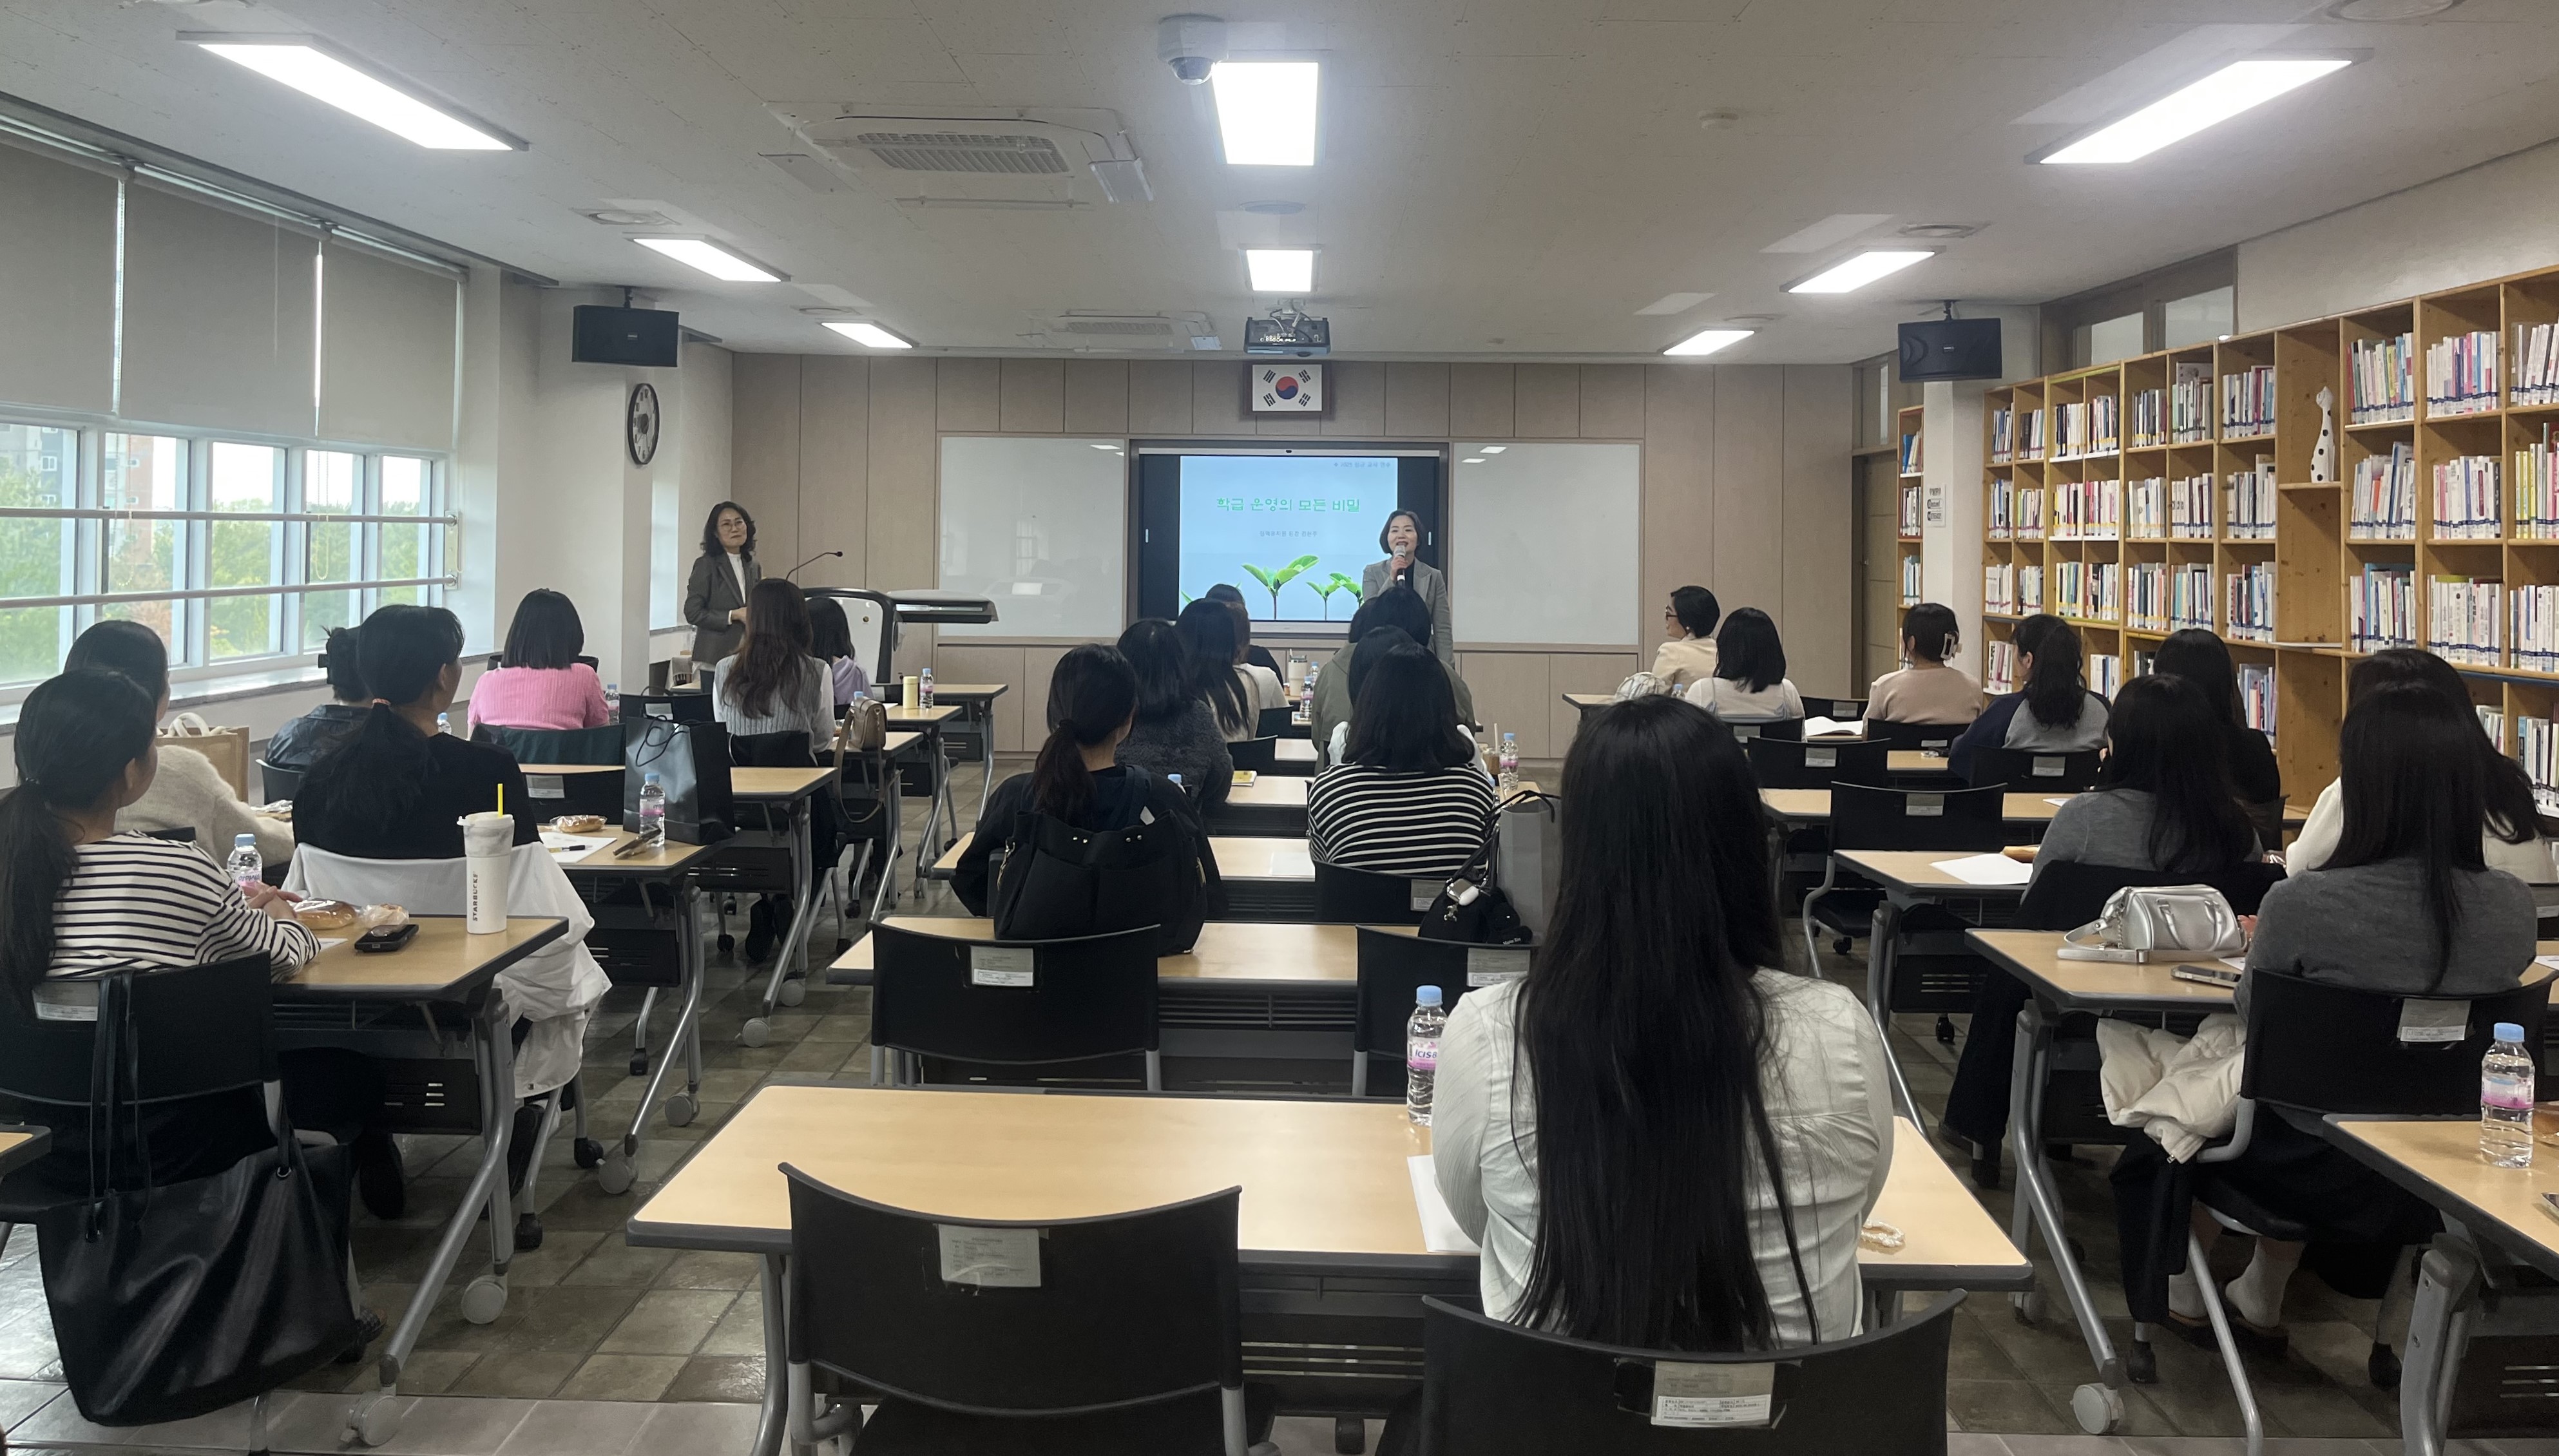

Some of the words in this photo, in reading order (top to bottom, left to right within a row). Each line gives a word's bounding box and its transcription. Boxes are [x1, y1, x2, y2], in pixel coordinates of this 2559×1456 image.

[1216, 498, 1244, 512] 학급
[1251, 498, 1292, 512] 운영의
[1298, 499, 1327, 512] 모든
[1332, 499, 1360, 512] 비밀
